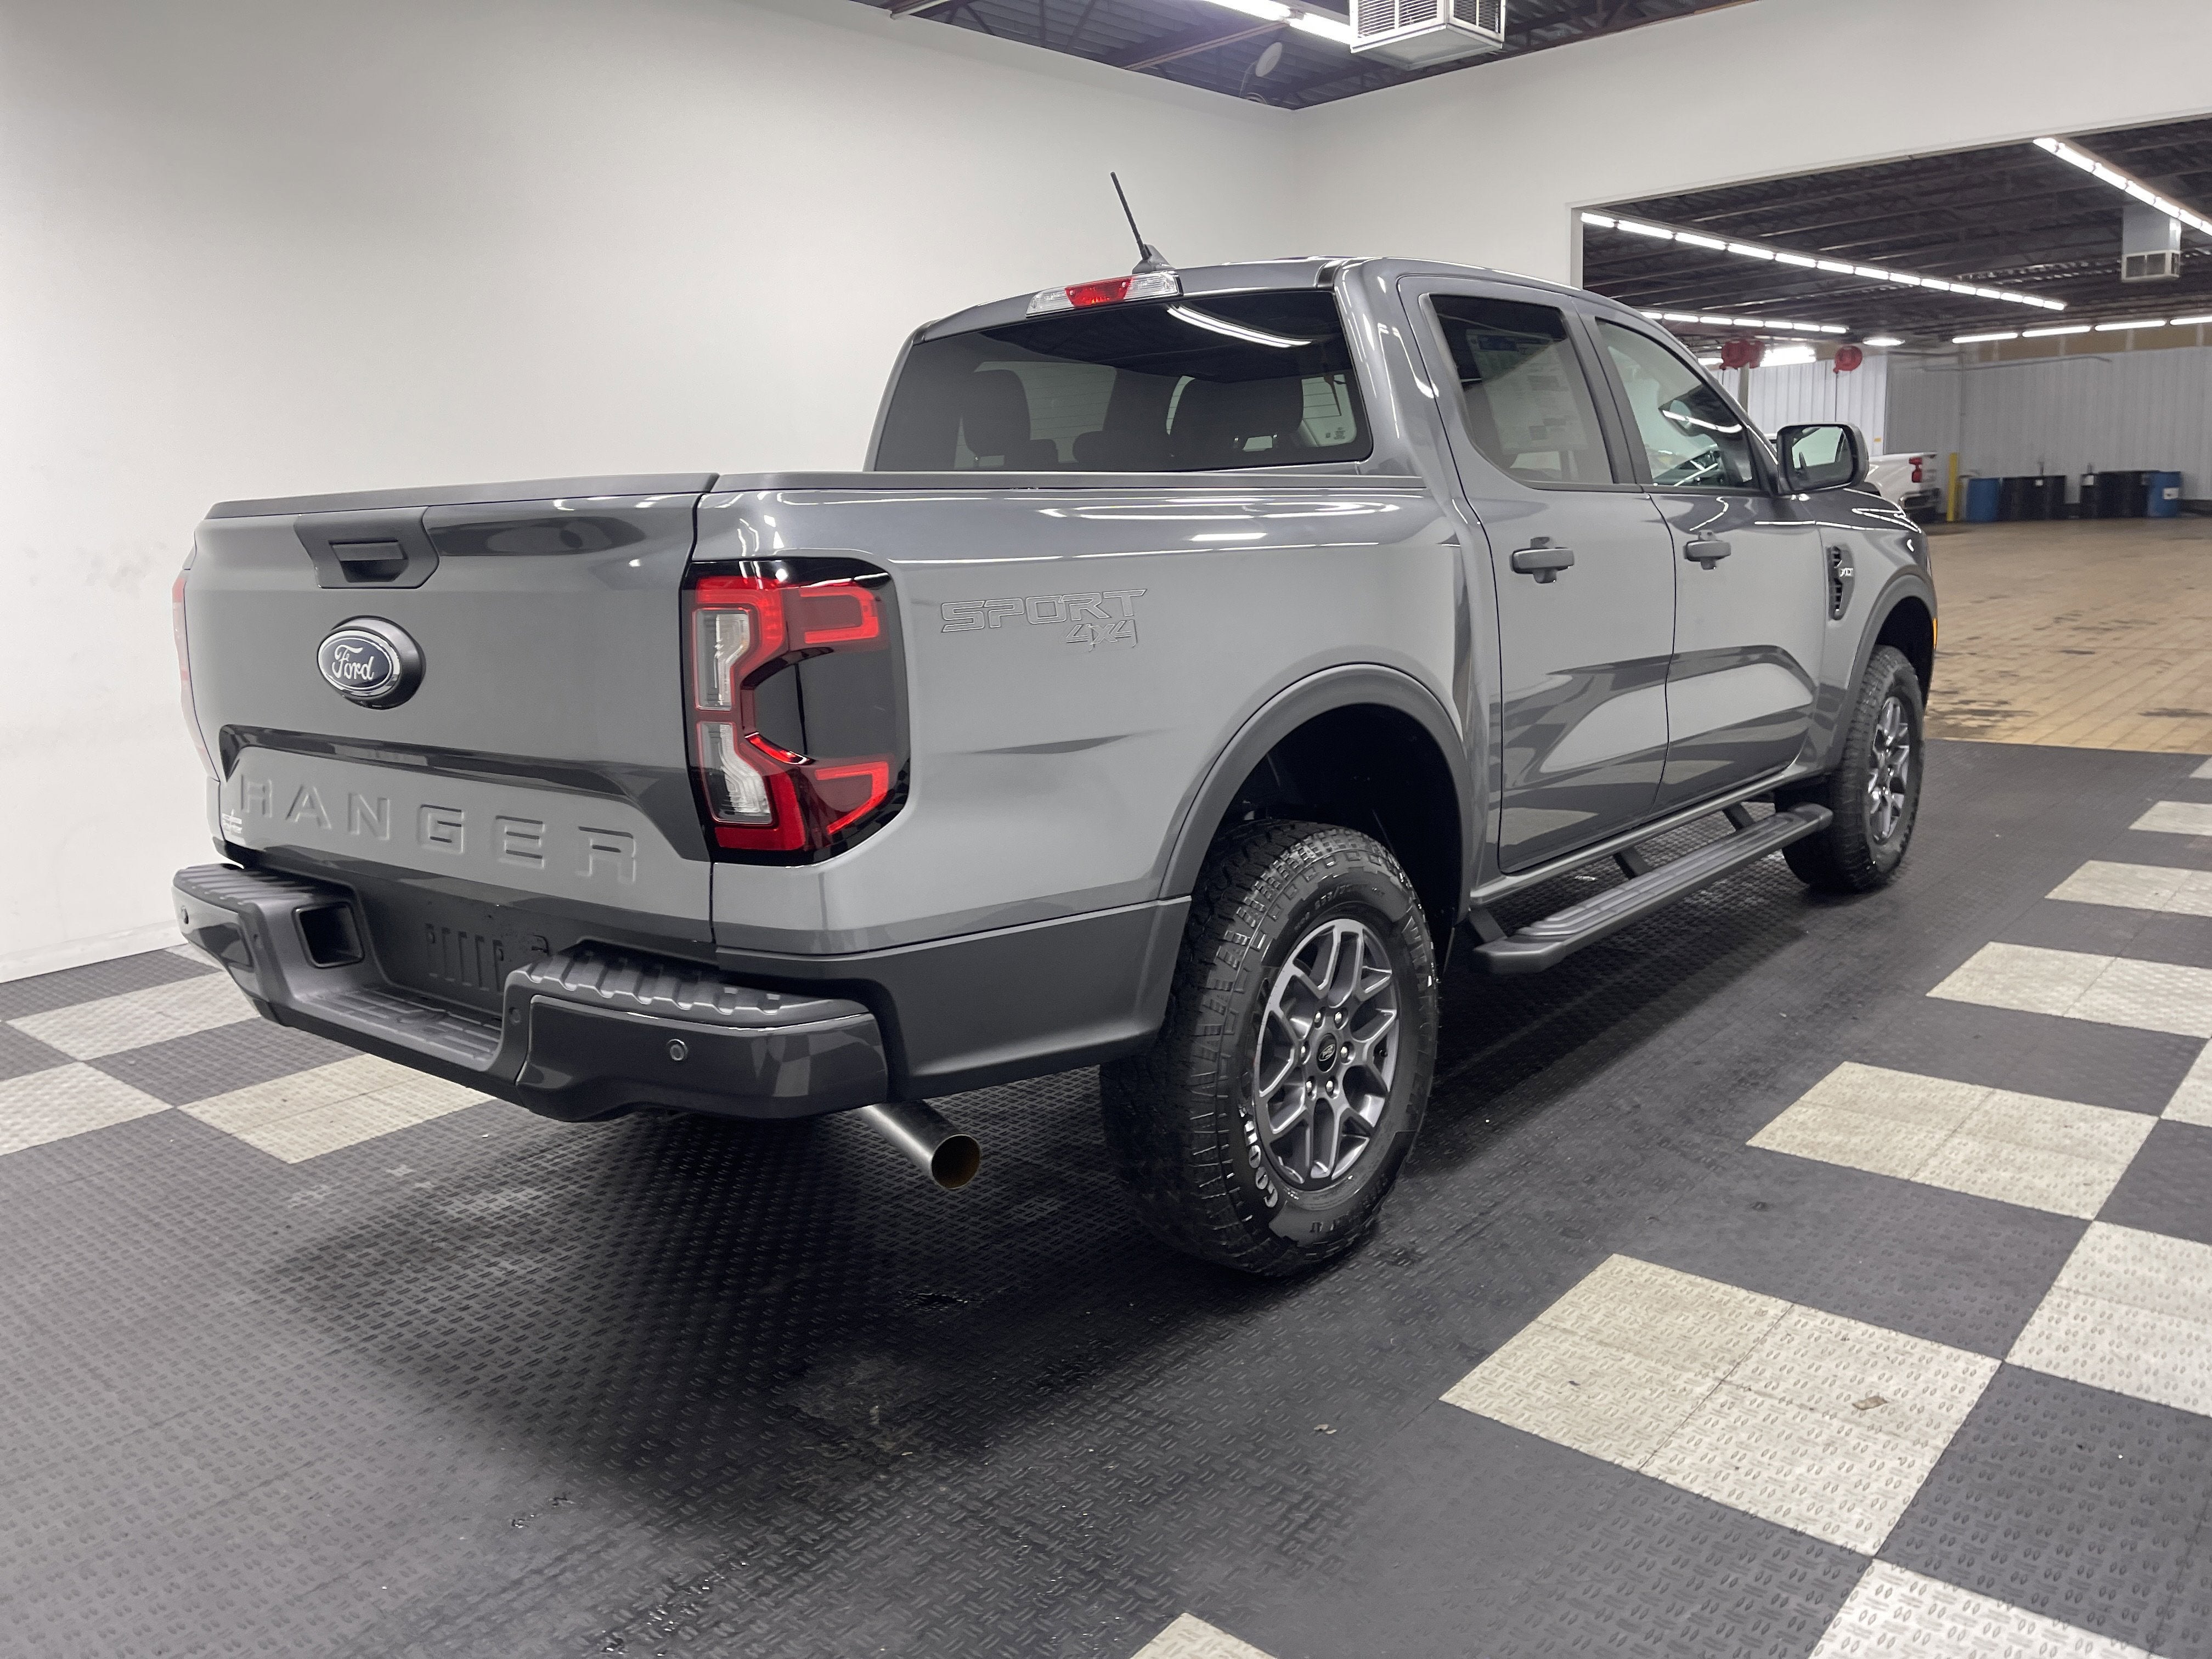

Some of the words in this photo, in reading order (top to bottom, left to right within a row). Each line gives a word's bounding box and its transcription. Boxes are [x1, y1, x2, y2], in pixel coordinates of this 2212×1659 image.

[941, 589, 1147, 633] SPORT
[331, 644, 374, 680] Ford
[240, 774, 636, 882] RANGER
